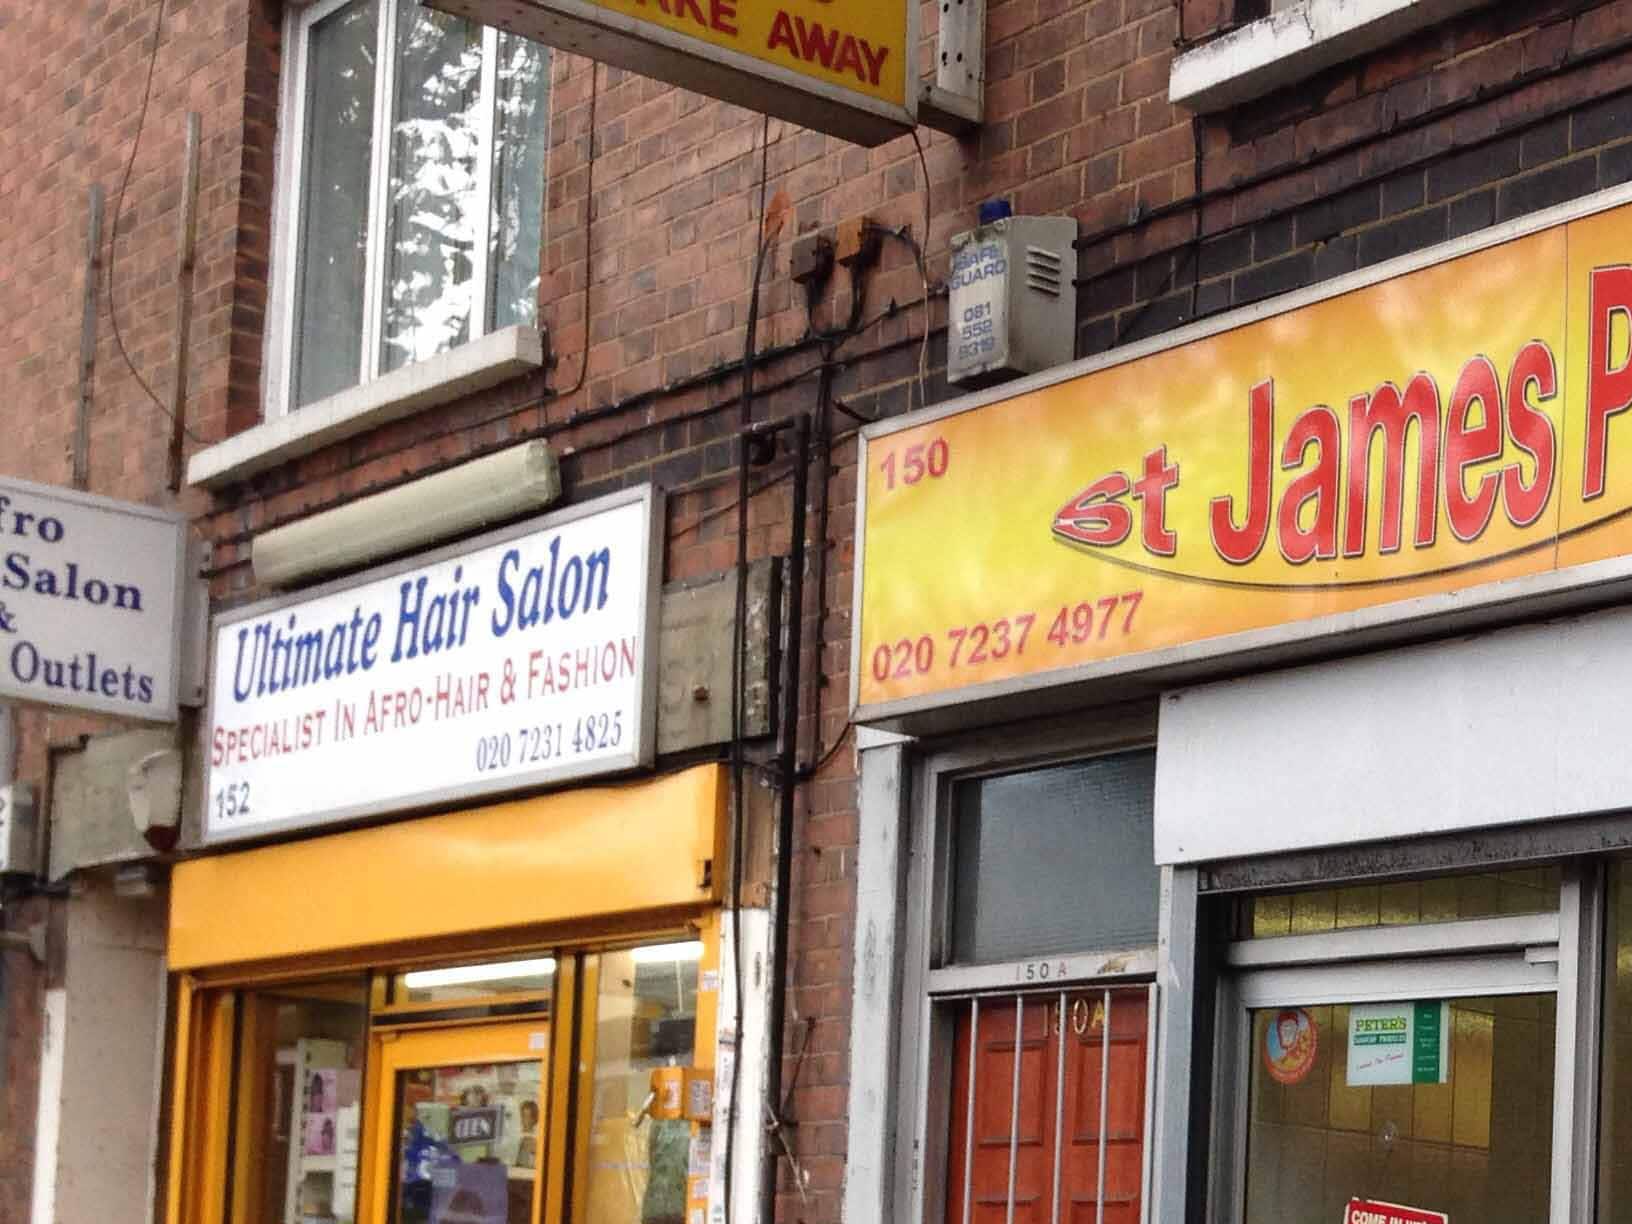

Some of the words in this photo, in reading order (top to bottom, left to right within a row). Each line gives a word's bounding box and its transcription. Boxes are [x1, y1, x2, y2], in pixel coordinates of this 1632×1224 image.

[634, 0, 739, 37] KE
[767, 10, 889, 86] AWAY
[879, 437, 950, 493] 150
[1208, 339, 1559, 566] James
[2, 552, 144, 611] Salon
[233, 606, 382, 703] Ultimate
[391, 565, 480, 664] Hair
[492, 535, 610, 638] Salon
[872, 637, 935, 685] 020
[948, 612, 1033, 671] 7237
[1047, 590, 1144, 651] 4977
[10, 640, 153, 702] Outlets
[212, 710, 326, 767] SPECIALIST
[363, 671, 491, 736] AFRO-HAIR
[499, 657, 516, 705] &
[527, 635, 638, 700] FASHION
[476, 735, 511, 773] 020
[518, 723, 563, 763] 7231
[571, 710, 622, 753] 4825
[215, 781, 250, 818] 152
